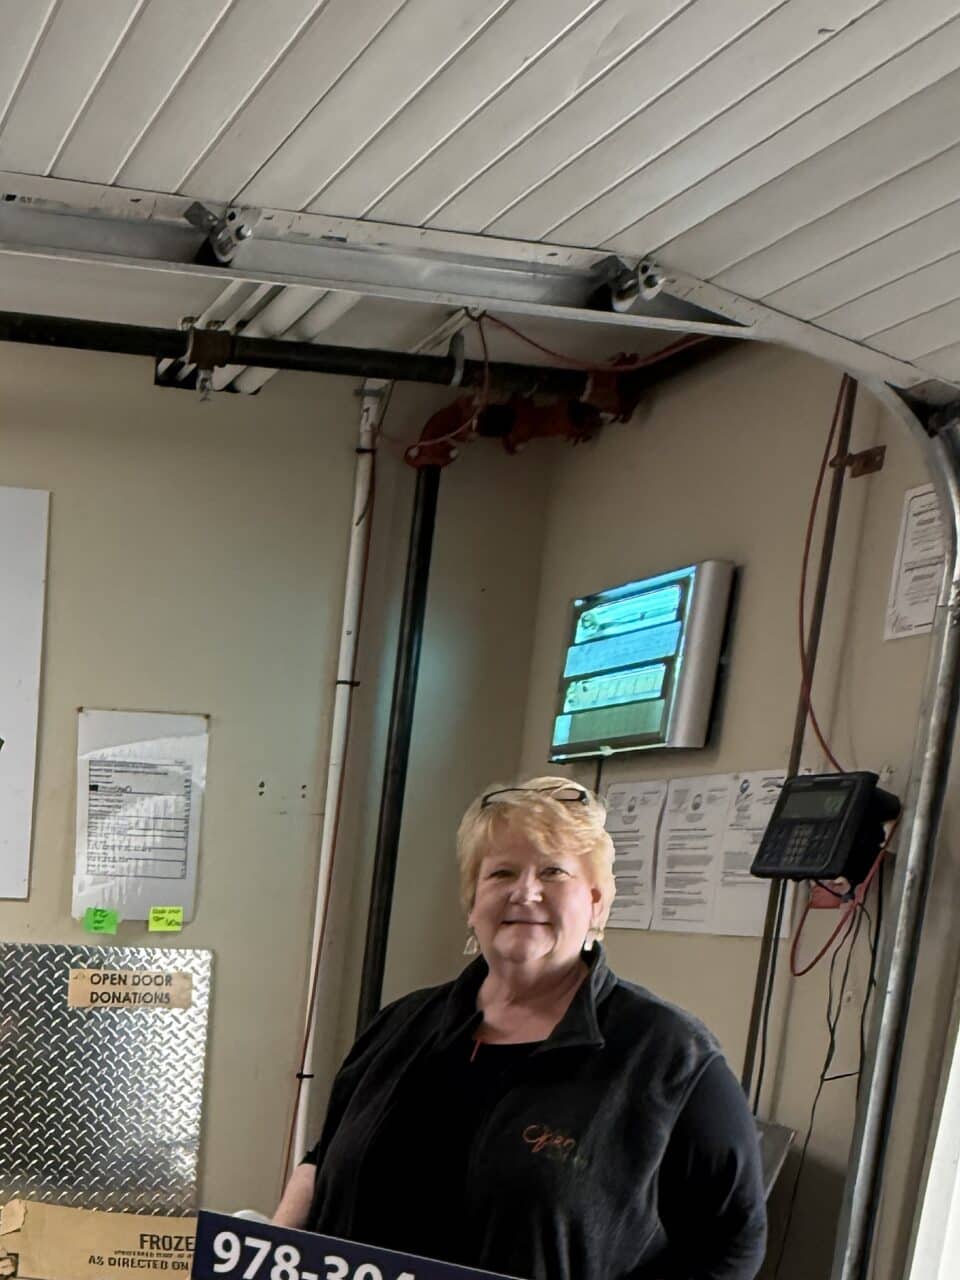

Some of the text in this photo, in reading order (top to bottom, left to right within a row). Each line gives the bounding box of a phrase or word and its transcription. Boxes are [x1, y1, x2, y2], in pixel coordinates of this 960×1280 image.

[90, 973, 173, 987] OPEN DOOR
[90, 991, 171, 1004] DONATIONS
[140, 1233, 196, 1251] FROZE
[108, 1257, 168, 1270] DIRECTED
[171, 1261, 189, 1271] ON
